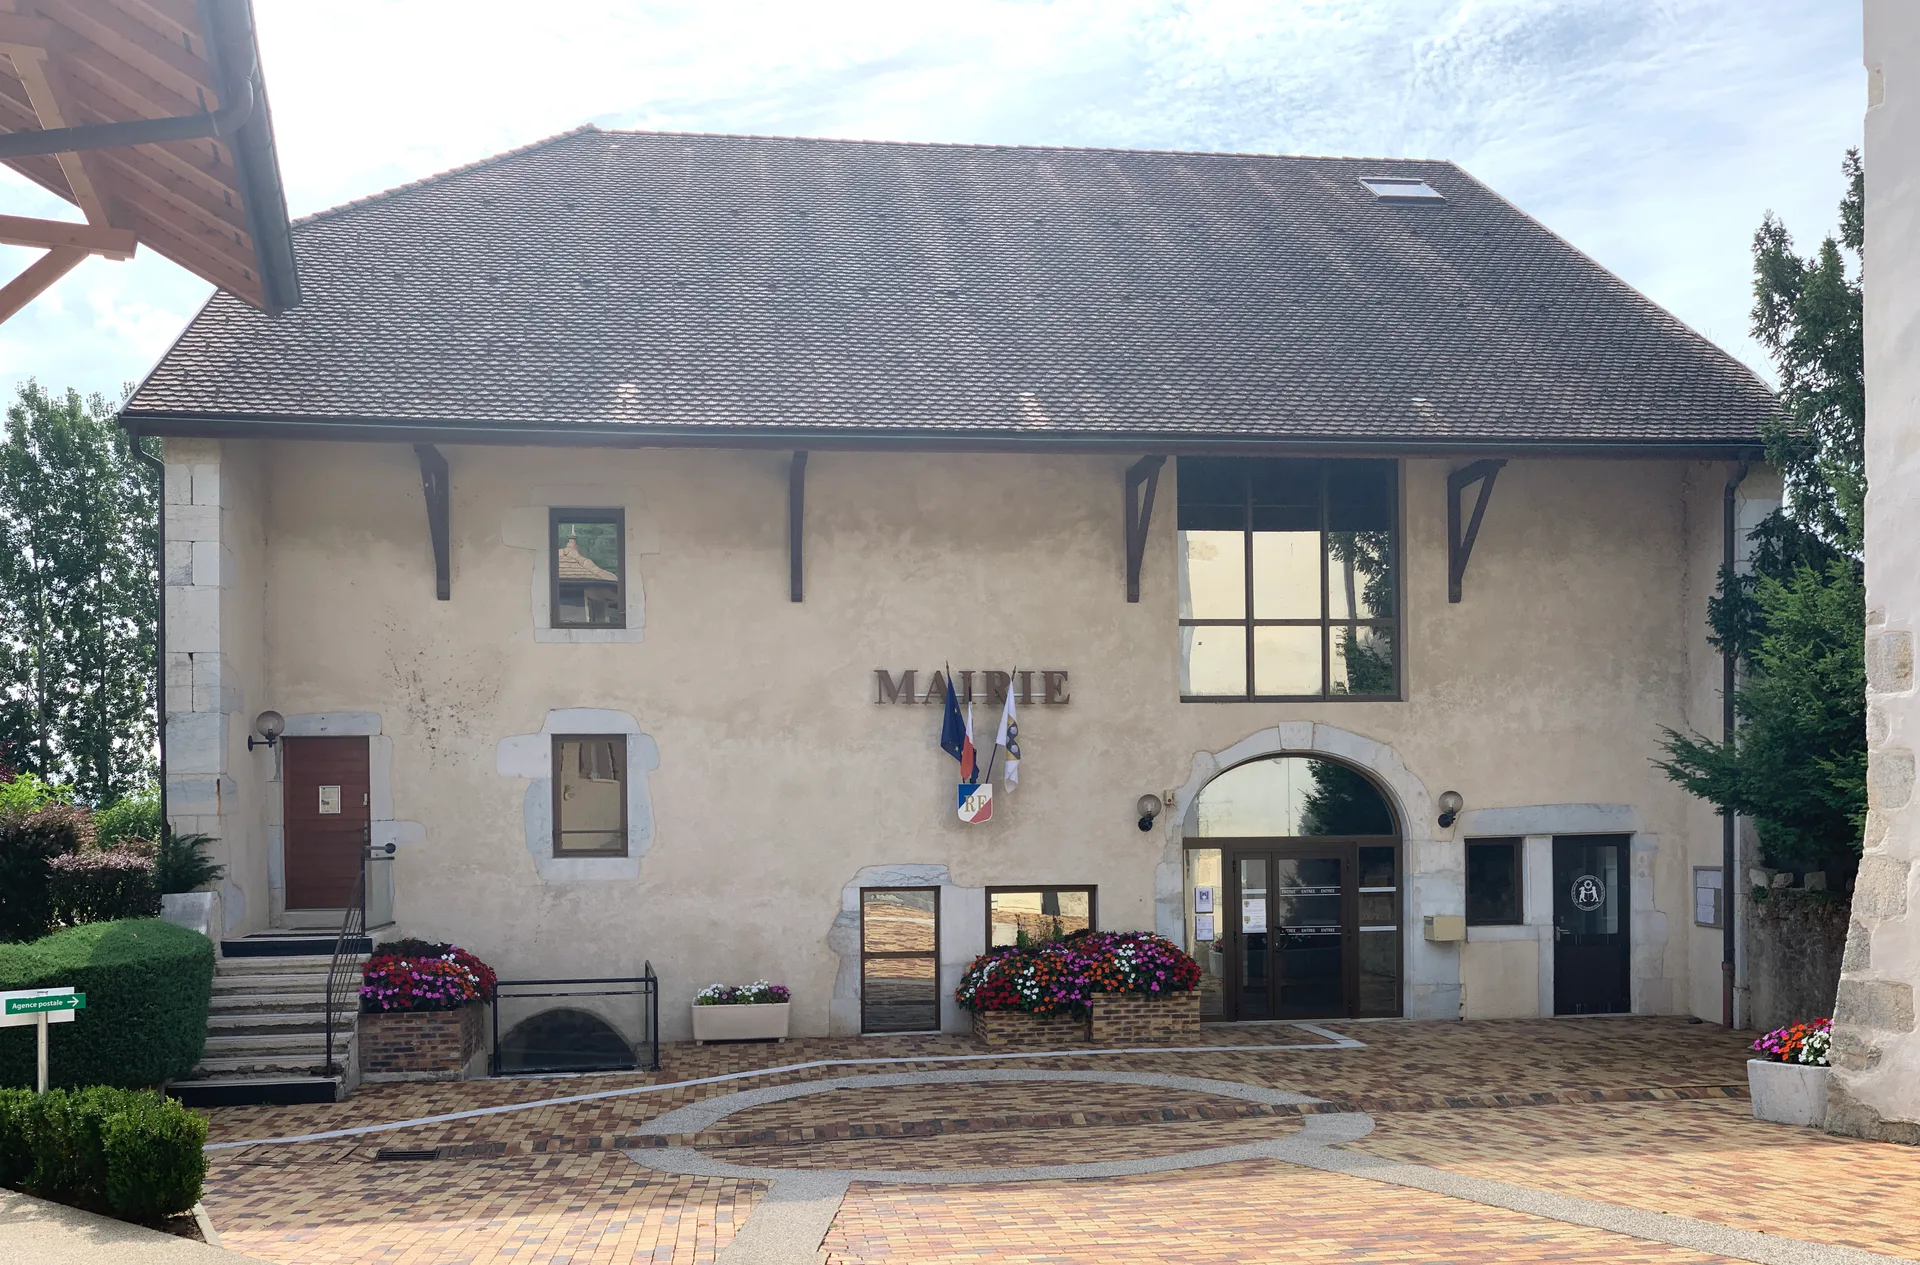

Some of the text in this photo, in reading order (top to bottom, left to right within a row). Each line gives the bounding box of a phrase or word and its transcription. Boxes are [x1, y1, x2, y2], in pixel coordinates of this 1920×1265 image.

[874, 669, 1070, 706] MAIRIE
[964, 794, 988, 813] RF
[12, 1000, 63, 1010] Agence postale
